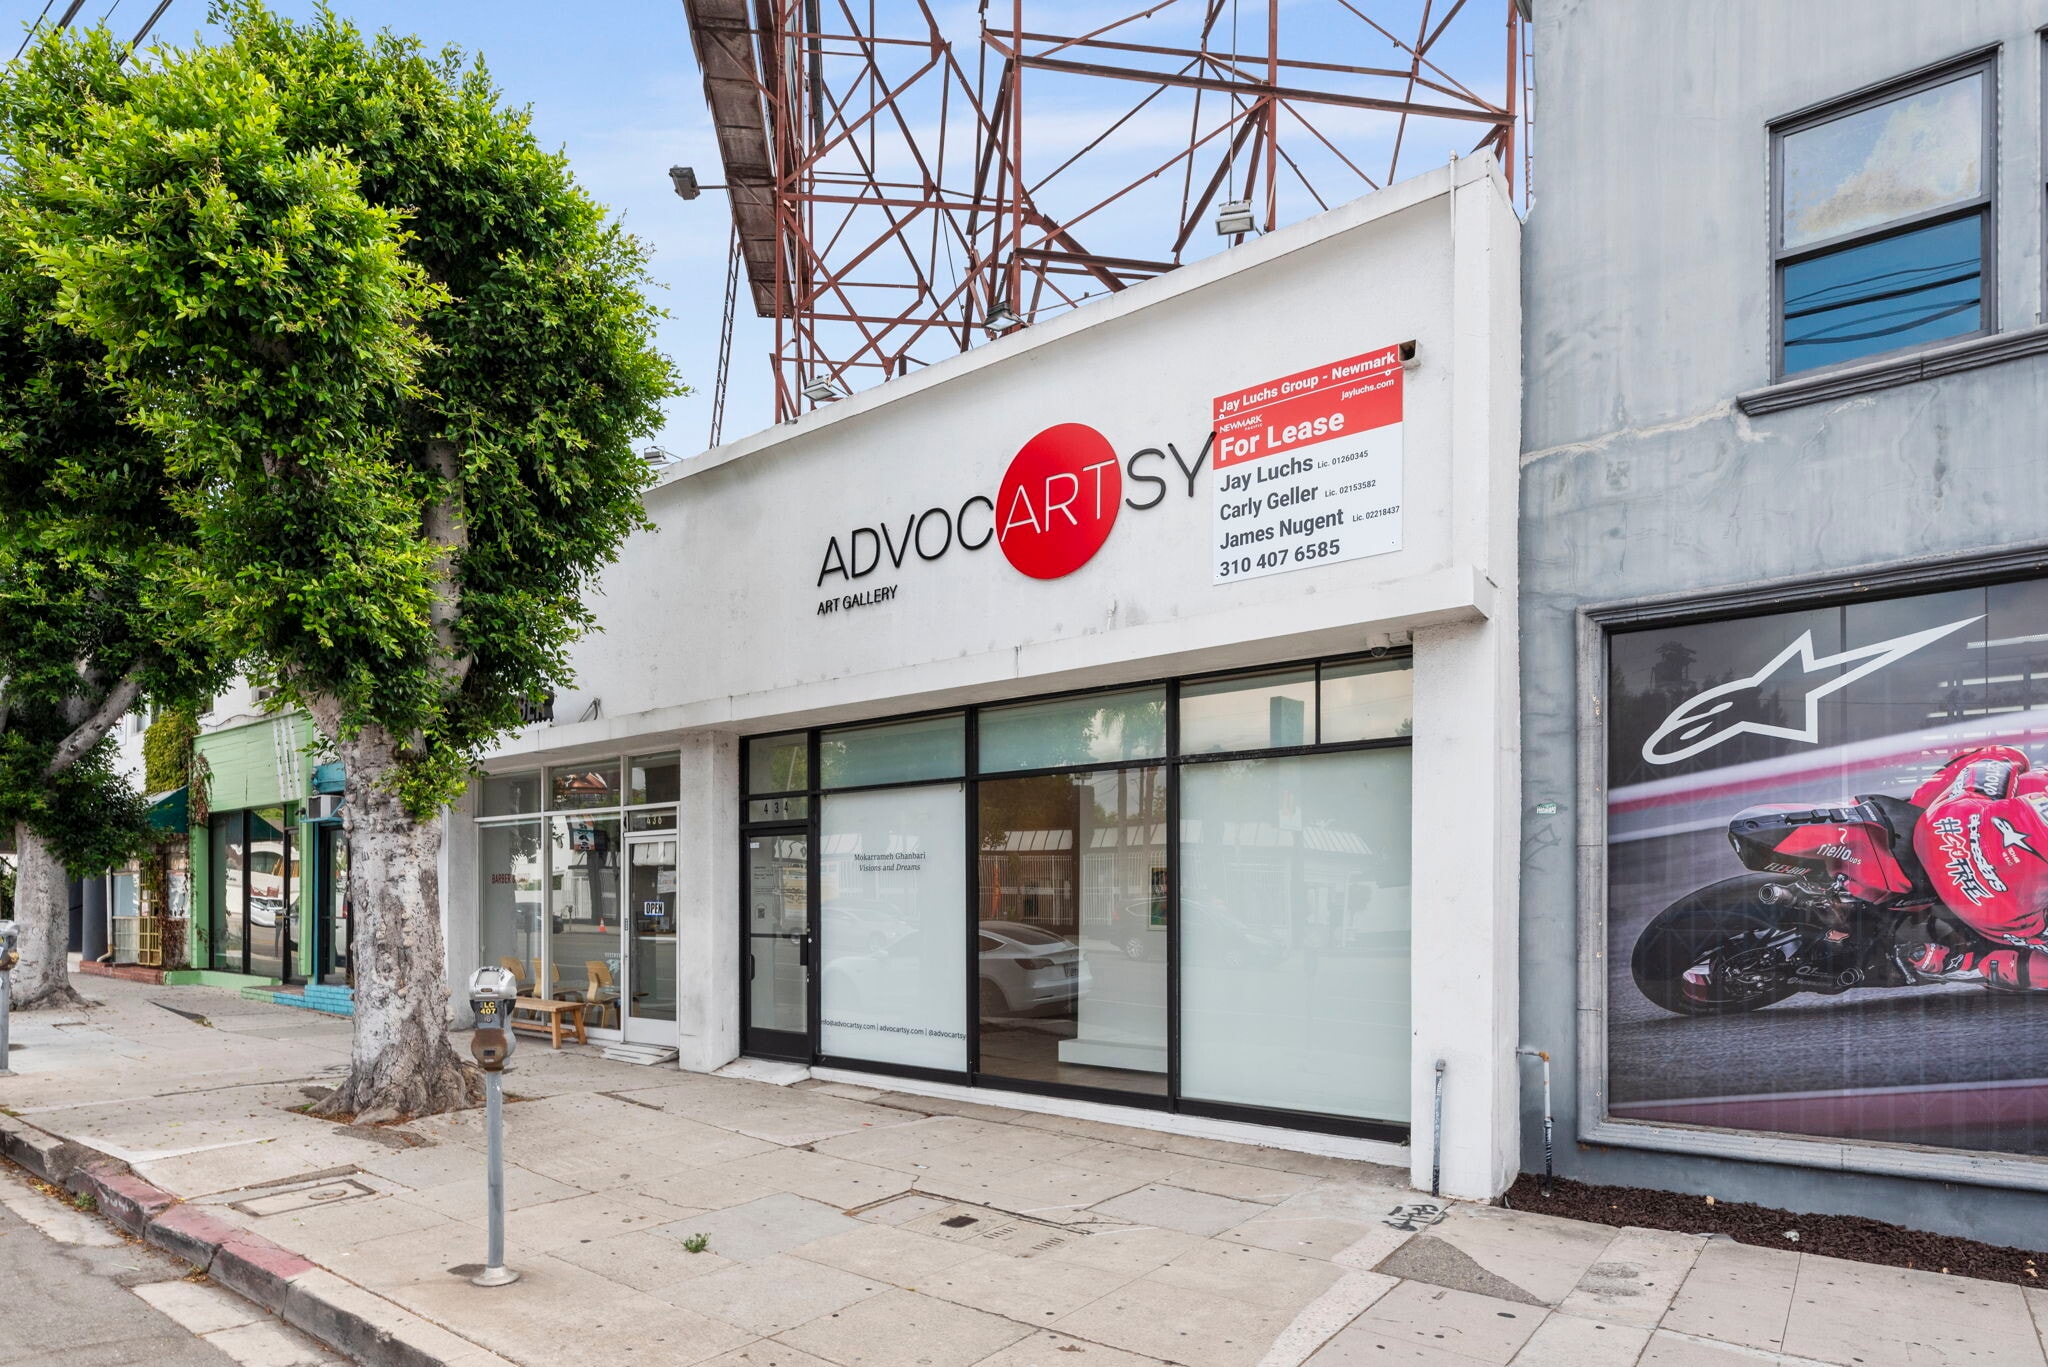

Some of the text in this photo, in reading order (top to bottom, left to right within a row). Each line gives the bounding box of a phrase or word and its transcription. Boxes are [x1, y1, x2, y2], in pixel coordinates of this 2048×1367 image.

[1220, 398, 1240, 413] Jay
[1243, 388, 1278, 406] Luchs
[1281, 374, 1319, 395] Group
[1332, 352, 1395, 380] Newmark
[1341, 378, 1394, 401] jayluchs.com
[1219, 414, 1263, 434] NEWMARK
[1220, 411, 1345, 461] For Lease
[1220, 450, 1369, 493] Jay Luchs Lic. 01260345
[1220, 479, 1377, 521] Carly Geller Lic. 02153582
[1220, 505, 1400, 550] James Nugent Lic. 02218437
[1220, 539, 1341, 577] 310 407 6585
[817, 585, 898, 615] ART GALLERY
[854, 851, 926, 861] Mokarrameh Ghanbari
[1817, 843, 1851, 861] riello
[859, 864, 881, 872] Visions
[646, 903, 663, 914] OPEN
[821, 1018, 876, 1031] nfo@advocartsy.com
[879, 1024, 924, 1035] advocartsy.com
[928, 1030, 966, 1041] @advocartsy
